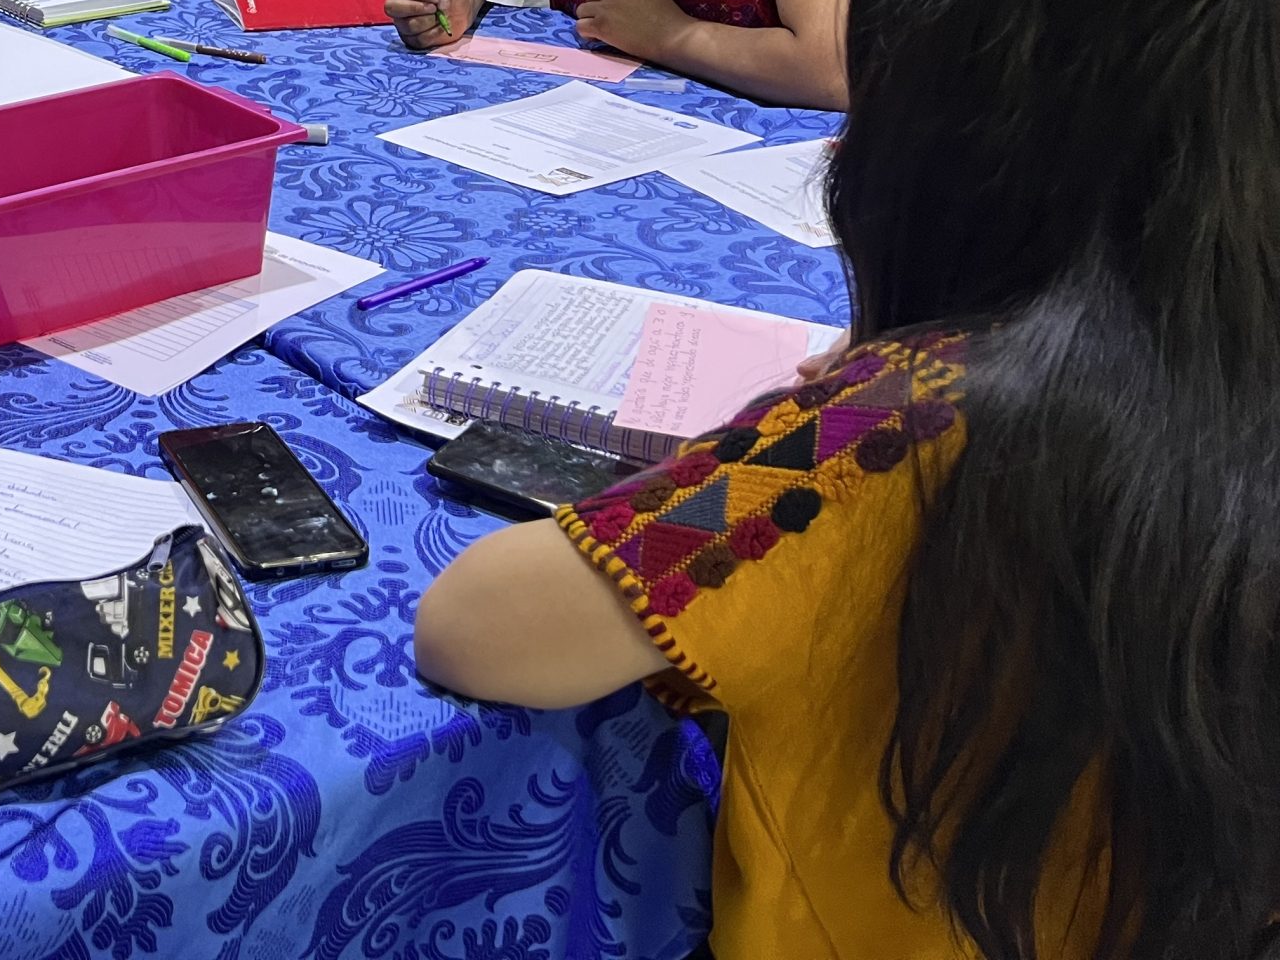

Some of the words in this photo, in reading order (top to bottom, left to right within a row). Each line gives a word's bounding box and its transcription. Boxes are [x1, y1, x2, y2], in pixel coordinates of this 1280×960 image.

[157, 586, 176, 659] MIXER
[152, 628, 214, 729] TOMICA
[41, 710, 79, 757] FIRE
